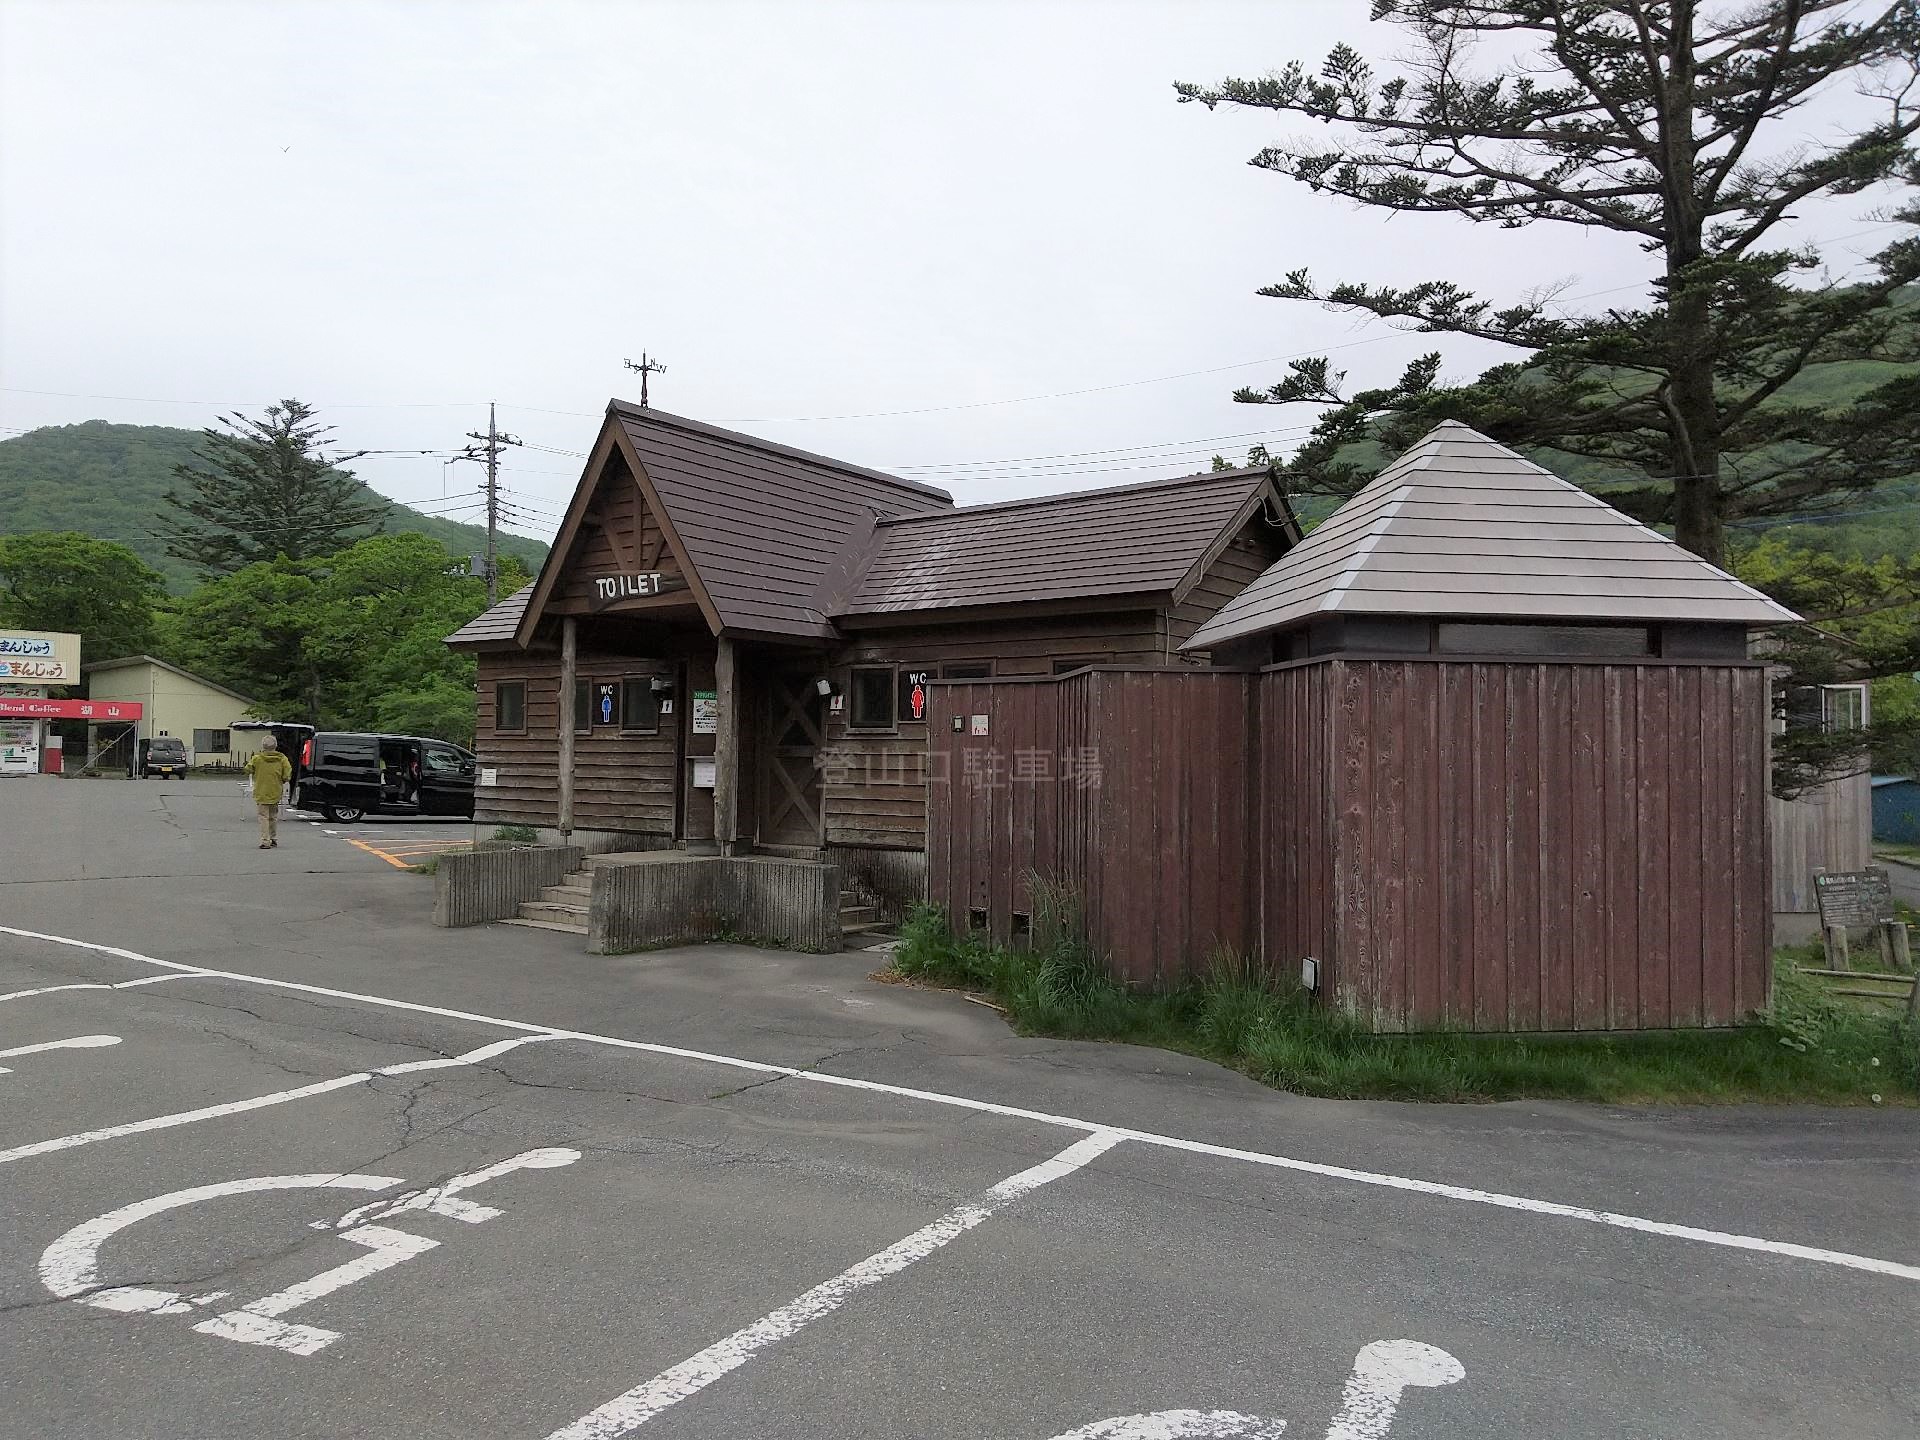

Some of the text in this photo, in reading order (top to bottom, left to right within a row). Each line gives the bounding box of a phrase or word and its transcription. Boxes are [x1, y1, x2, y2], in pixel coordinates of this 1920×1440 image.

[596, 573, 661, 599] TOILET
[0, 640, 50, 655] まんじゅう
[9, 661, 63, 677] まんじゅう
[909, 672, 927, 684] WC
[600, 685, 613, 695] WC
[28, 704, 61, 713] Coffee
